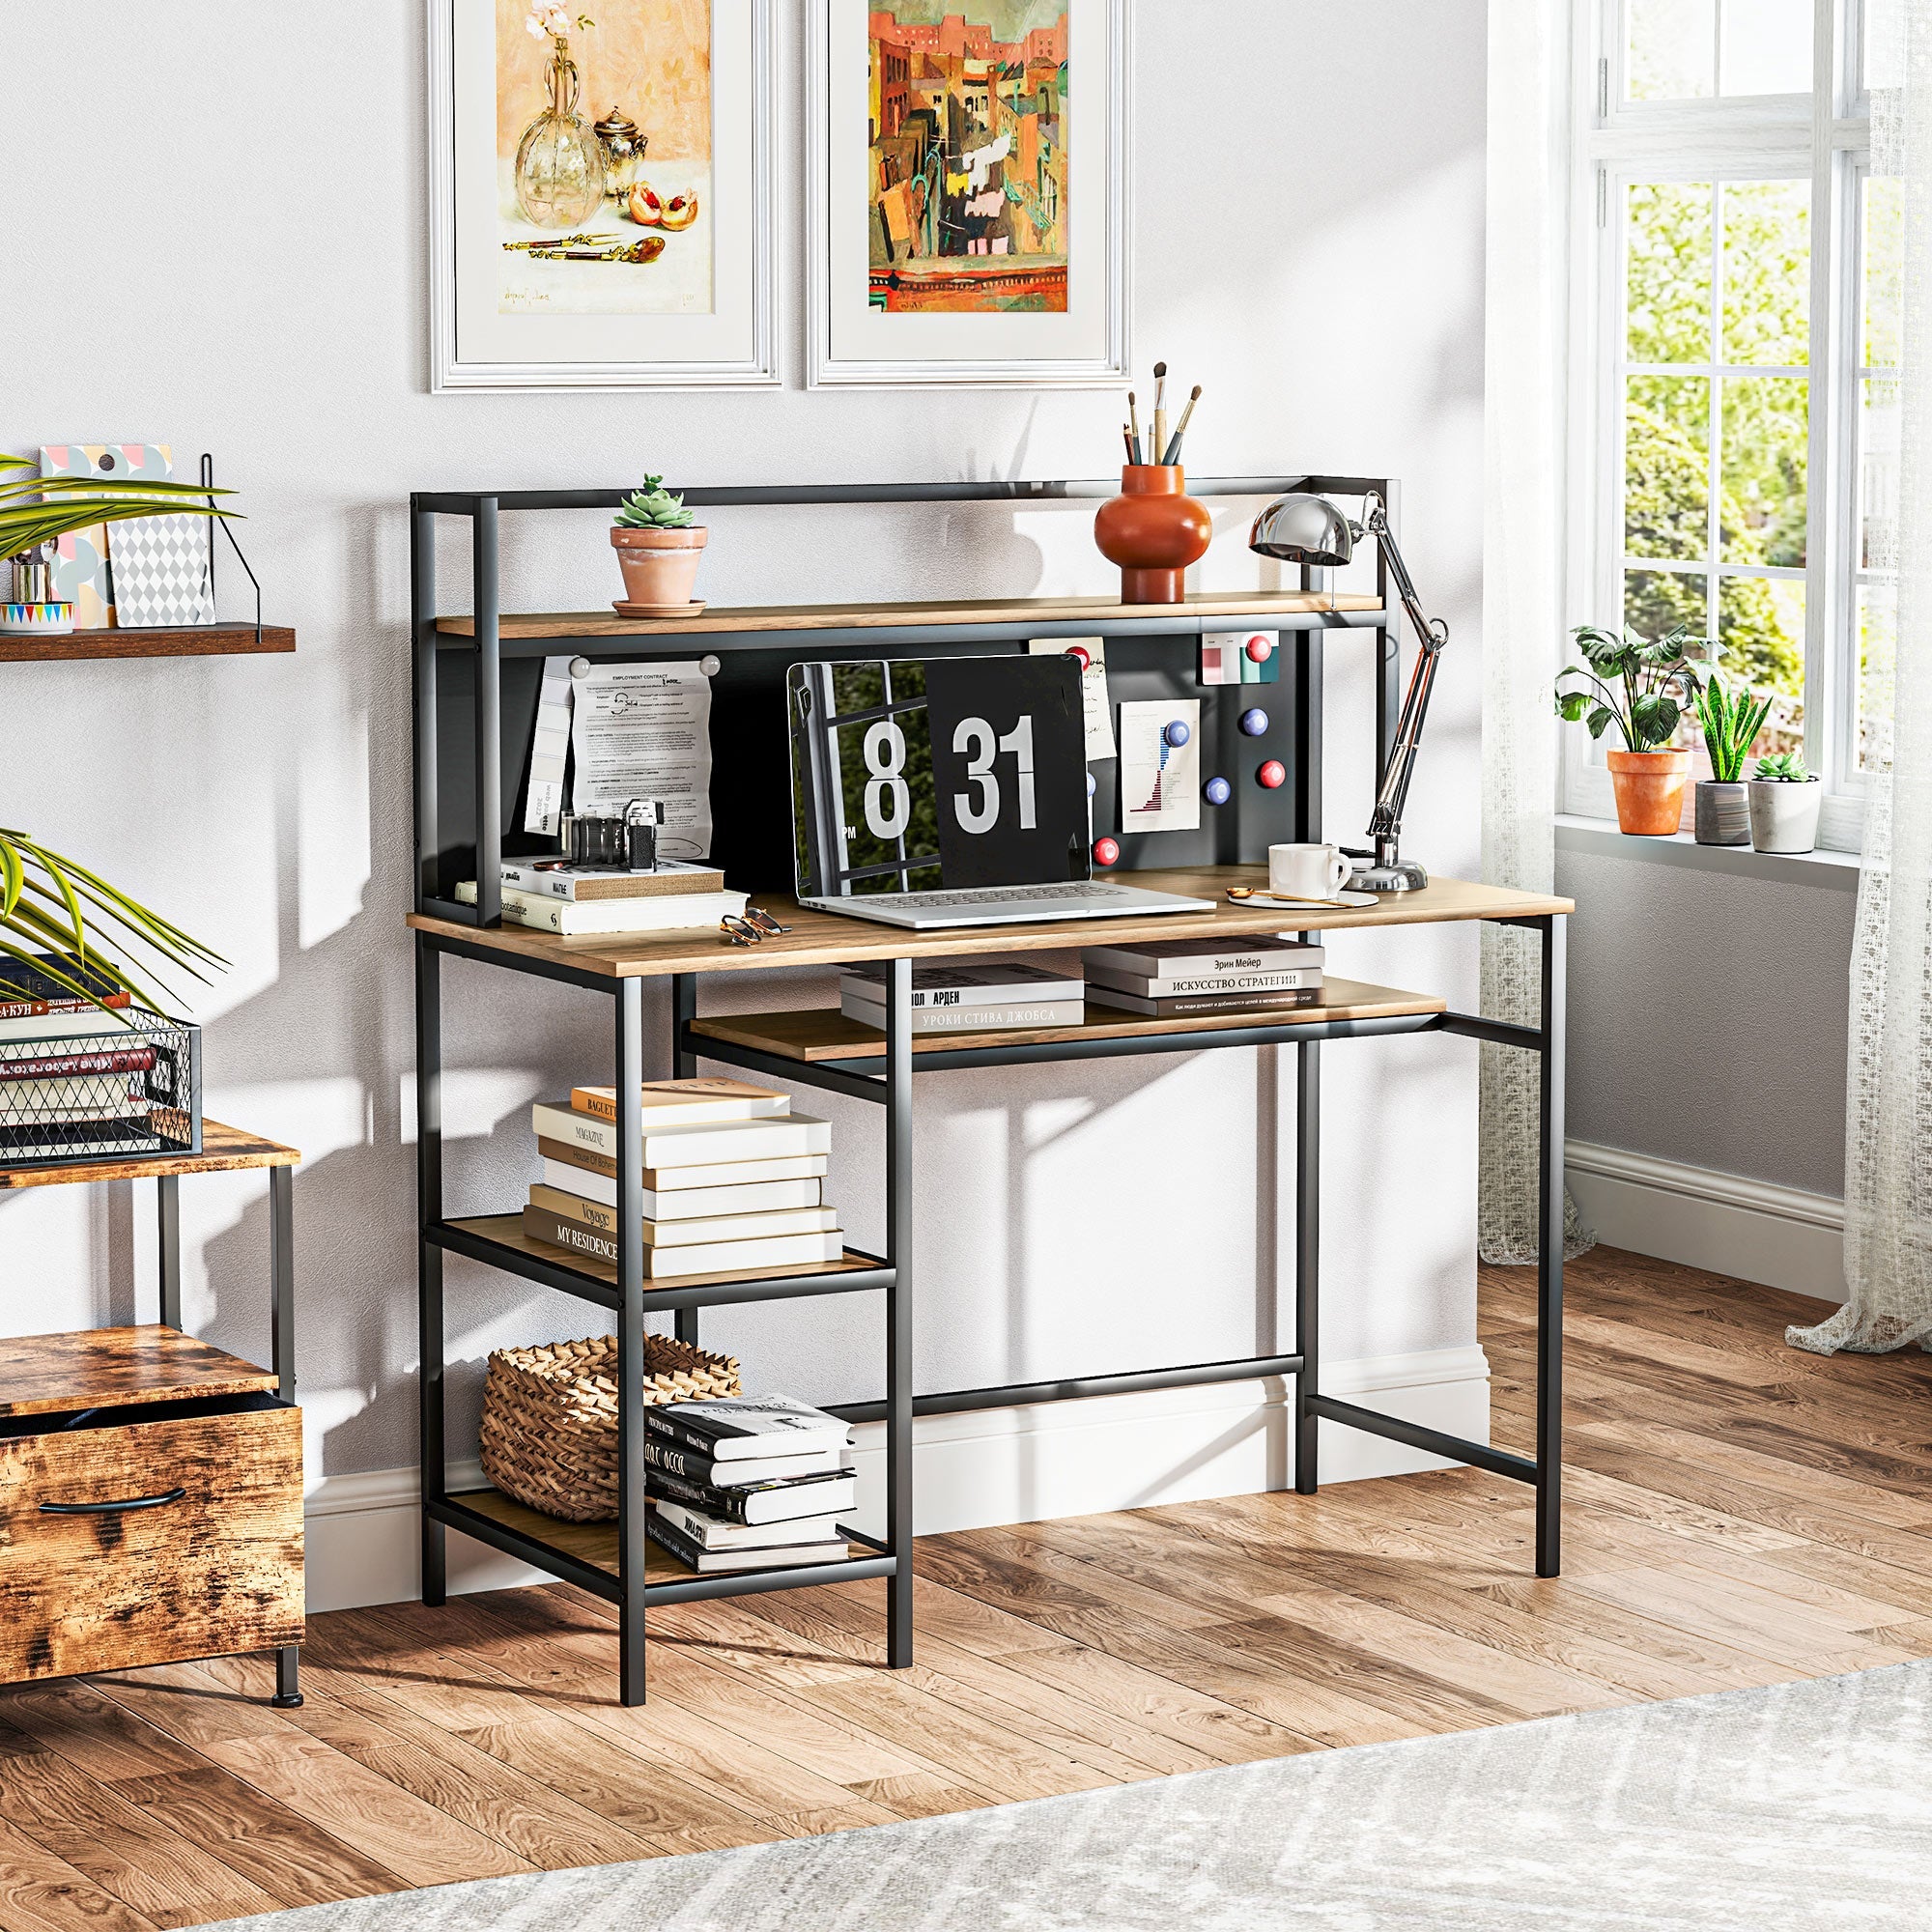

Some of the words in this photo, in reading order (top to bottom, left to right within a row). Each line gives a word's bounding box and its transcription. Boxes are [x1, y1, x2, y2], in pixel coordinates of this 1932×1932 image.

[863, 721, 910, 839] 8
[952, 715, 1037, 835] 31
[841, 826, 857, 839] PM
[1214, 959, 1235, 971] Эрин
[1236, 957, 1262, 968] Мейер
[1173, 978, 1236, 991] ИСКУССТВО
[1237, 975, 1296, 987] СТРАТЕГИИ
[933, 990, 960, 1007] АРДЕН
[923, 1014, 961, 1027] УРОКИ
[964, 1011, 1003, 1025] СТИВА
[1006, 1009, 1056, 1024] ДЖОБСА
[576, 1126, 605, 1148] MAGAZINE
[573, 1151, 589, 1164] House
[582, 1203, 611, 1229] Voyage
[557, 1224, 571, 1243] MY
[572, 1229, 618, 1261] RESIDENCE
